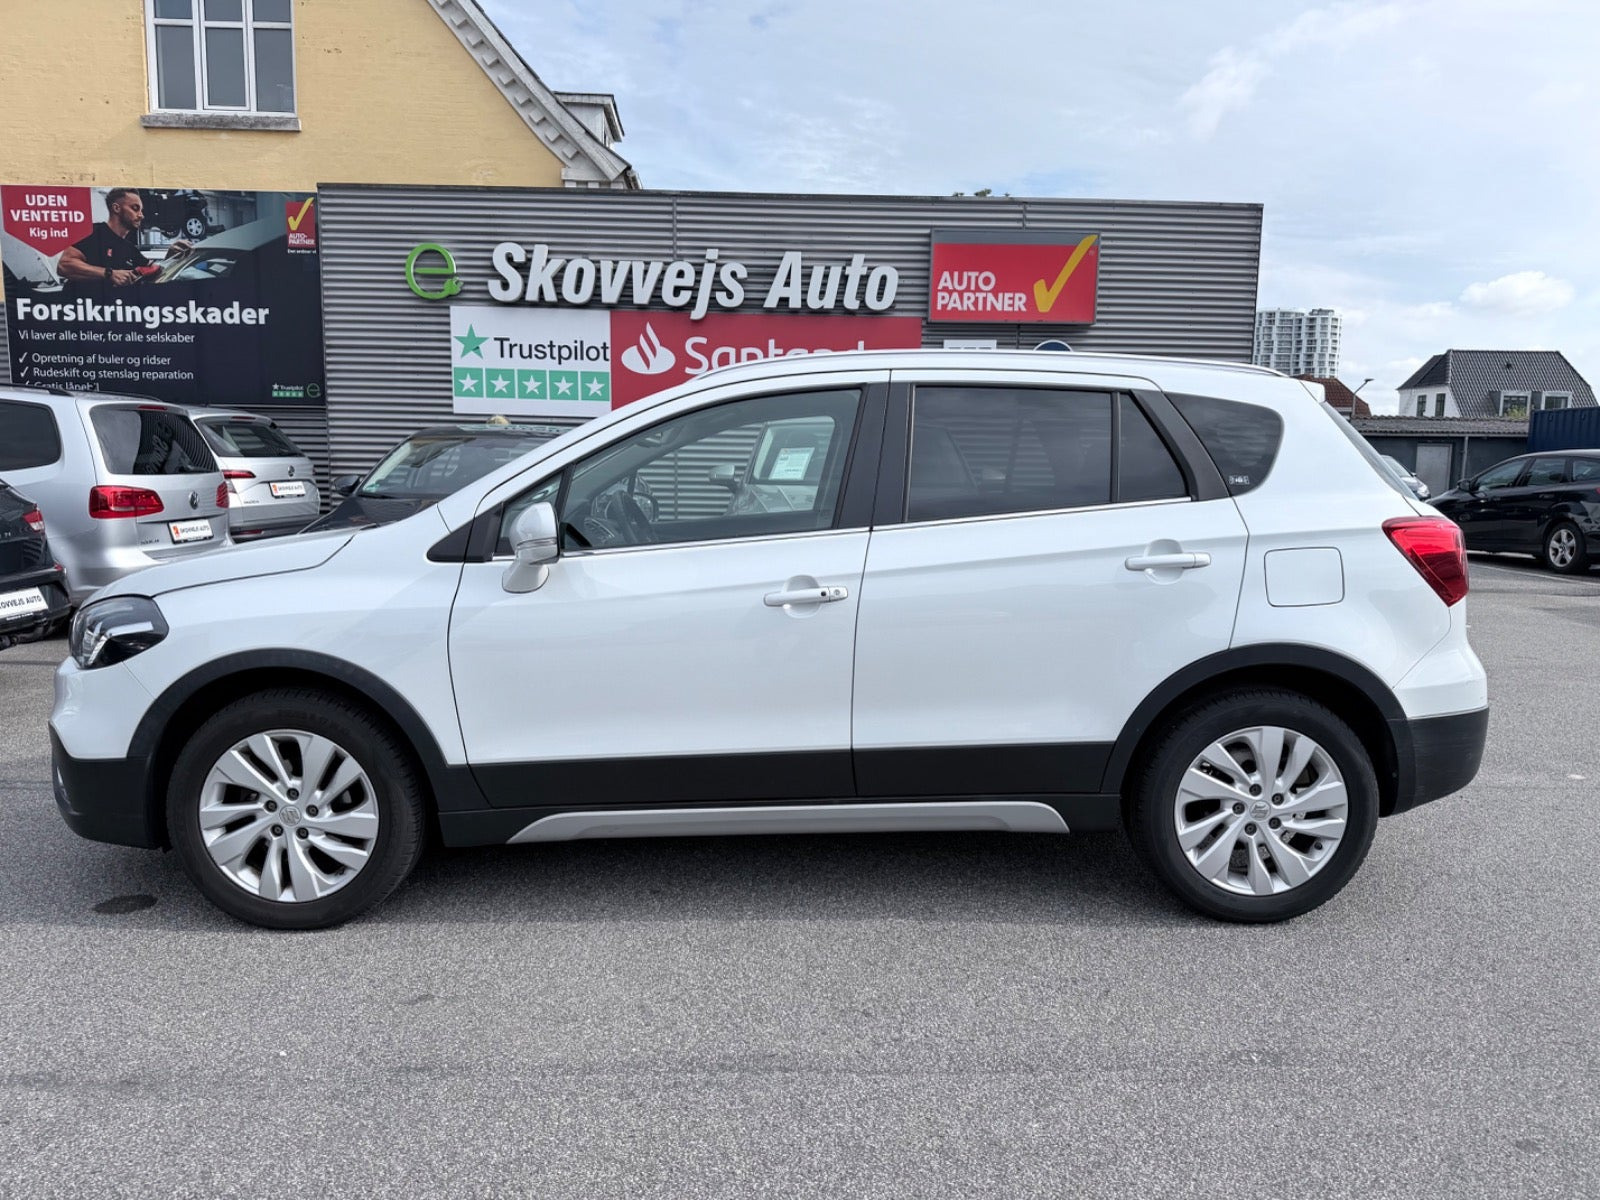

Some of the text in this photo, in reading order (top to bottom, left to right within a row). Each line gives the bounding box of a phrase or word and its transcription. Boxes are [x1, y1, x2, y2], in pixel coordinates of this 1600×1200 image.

[25, 194, 68, 207] UDEN
[10, 209, 85, 223] VENTETID
[29, 227, 68, 240] Kig ind
[487, 242, 899, 321] Skovvejs Auto
[937, 270, 996, 291] AUTO
[936, 291, 1027, 313] PARTNER
[16, 297, 270, 329] Forsikringsskader
[18, 329, 196, 344] Vi laver alle biler, for alle selskaber
[493, 336, 610, 366] Trustpilot
[31, 352, 171, 367] Opretning af buler og ridser
[33, 366, 194, 382] Rudeskift og stenslag reparation
[26, 595, 42, 605] AUTO
